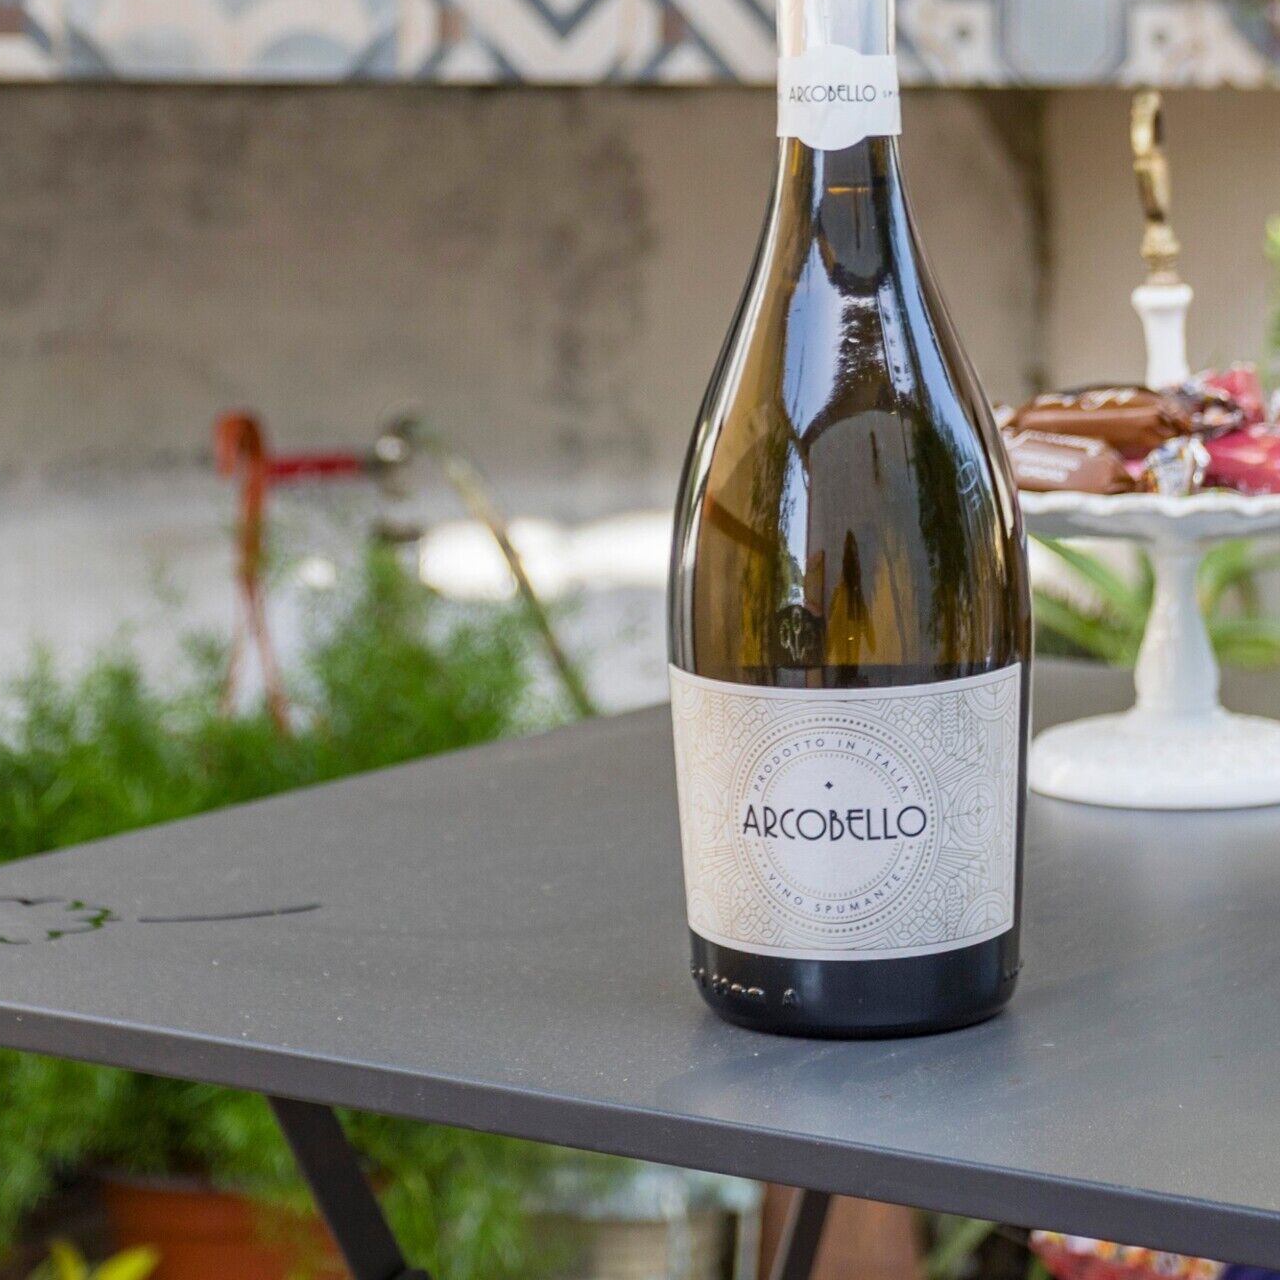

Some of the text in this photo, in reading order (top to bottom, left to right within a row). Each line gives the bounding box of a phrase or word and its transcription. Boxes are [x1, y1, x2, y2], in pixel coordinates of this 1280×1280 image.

[789, 84, 877, 103] ARCOBELLO
[754, 738, 909, 793] PRODOTTO IN ITALIA
[743, 804, 927, 842] ARCOBELLO
[769, 873, 901, 914] VINO SPUMANTE
